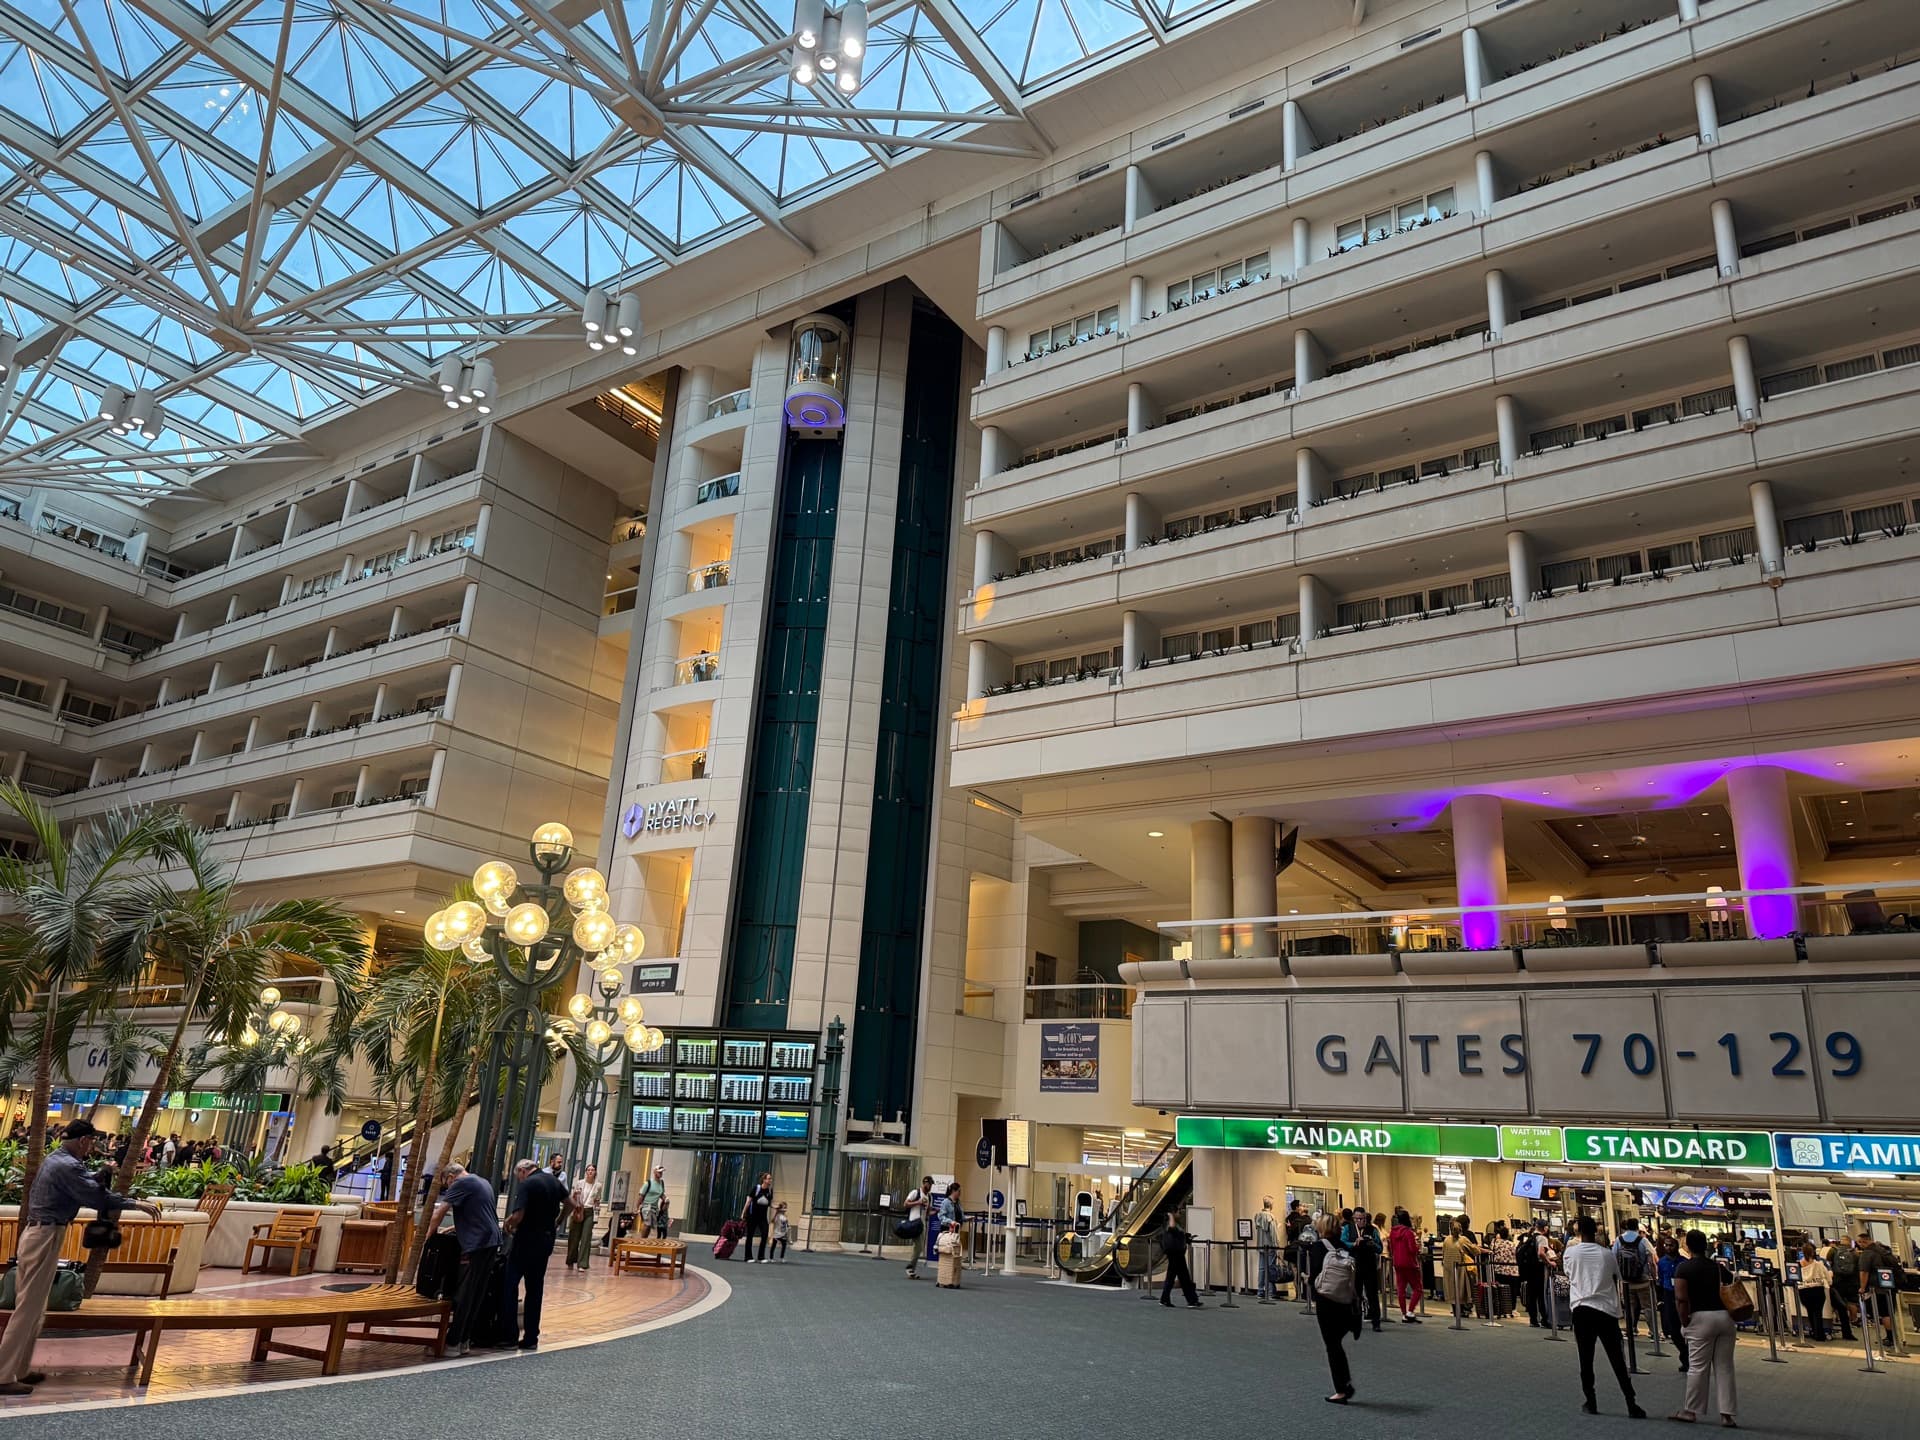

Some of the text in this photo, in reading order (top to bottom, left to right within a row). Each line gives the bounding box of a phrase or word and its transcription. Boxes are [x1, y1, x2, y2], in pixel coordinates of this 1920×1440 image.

[648, 797, 698, 815] HYATT
[646, 812, 715, 831] REGENCY
[1315, 1031, 1863, 1077] GATES 70-129
[1266, 1125, 1392, 1149] STANDARD
[1510, 1128, 1552, 1136] WAIT TIME
[1515, 1149, 1550, 1157] MINUTES
[1586, 1135, 1747, 1160] STANDARD
